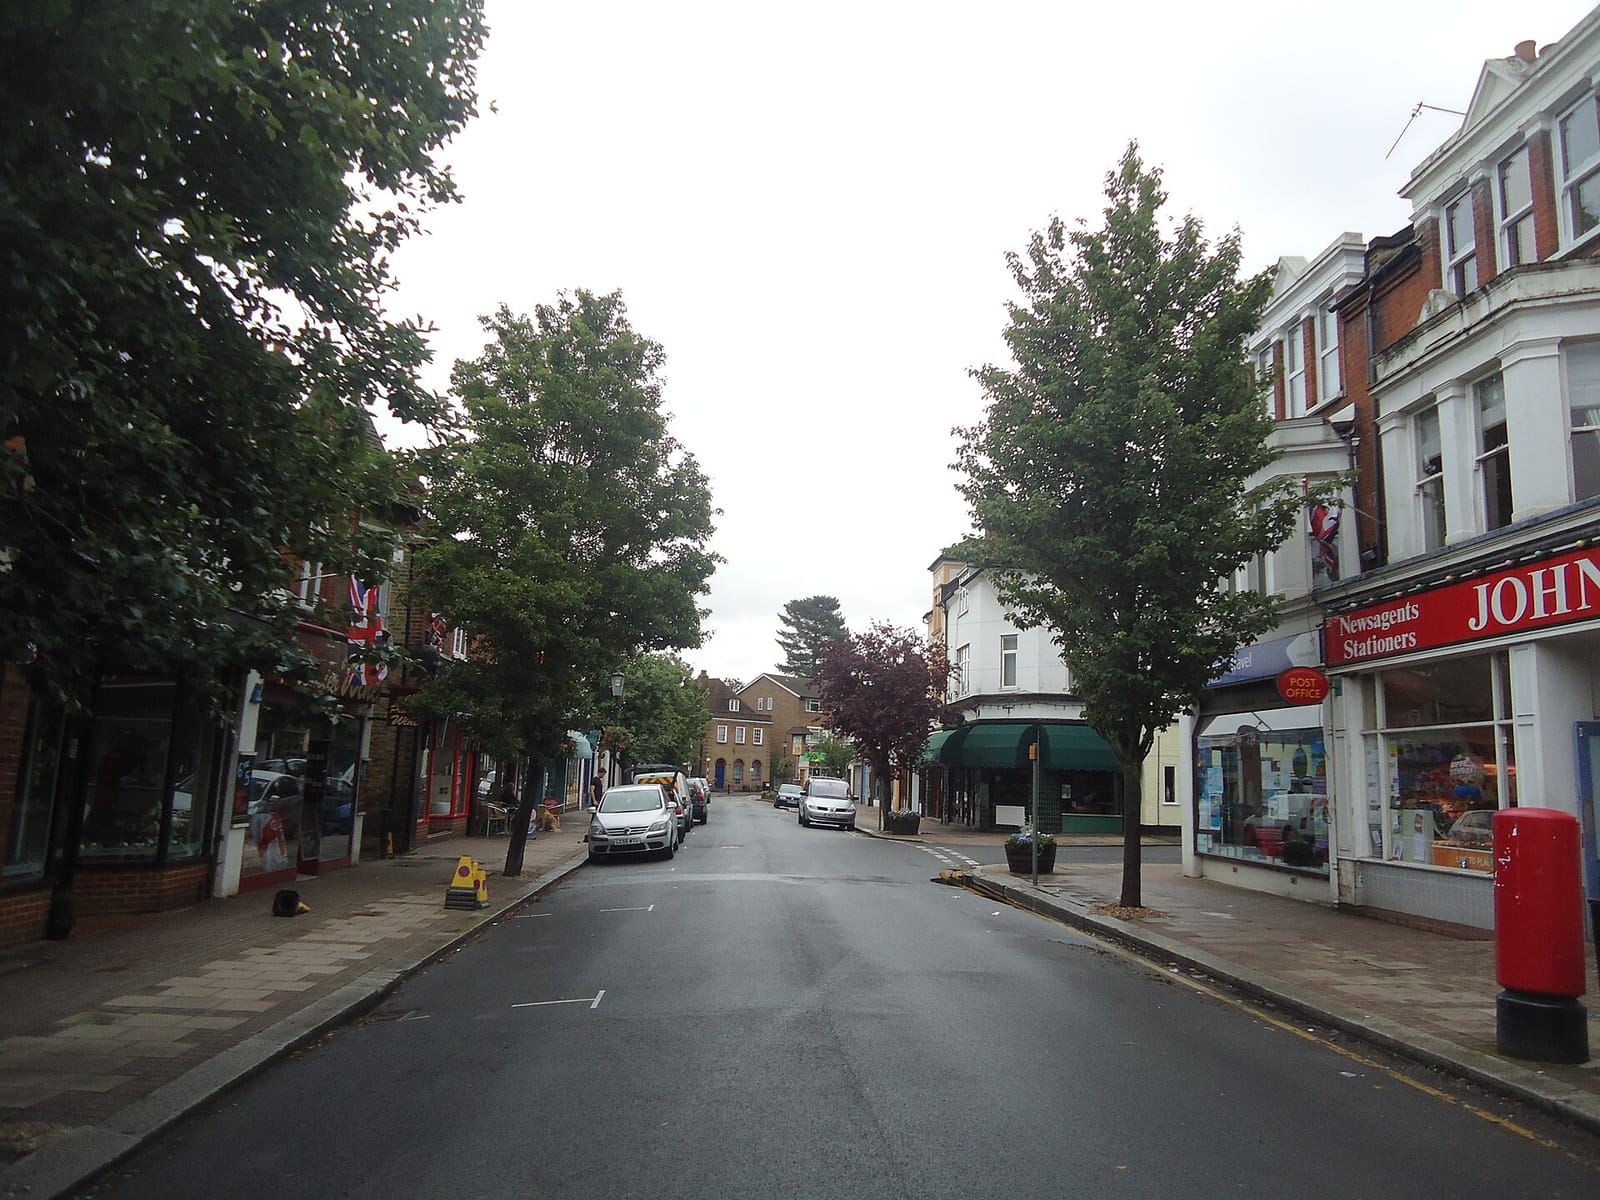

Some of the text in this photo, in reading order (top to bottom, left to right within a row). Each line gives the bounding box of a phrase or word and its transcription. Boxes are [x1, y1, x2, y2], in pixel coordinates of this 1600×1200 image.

[1339, 601, 1420, 637] Newsagents
[1344, 631, 1417, 659] Stationers
[1290, 677, 1317, 688] POST
[1286, 688, 1321, 698] OFFICE
